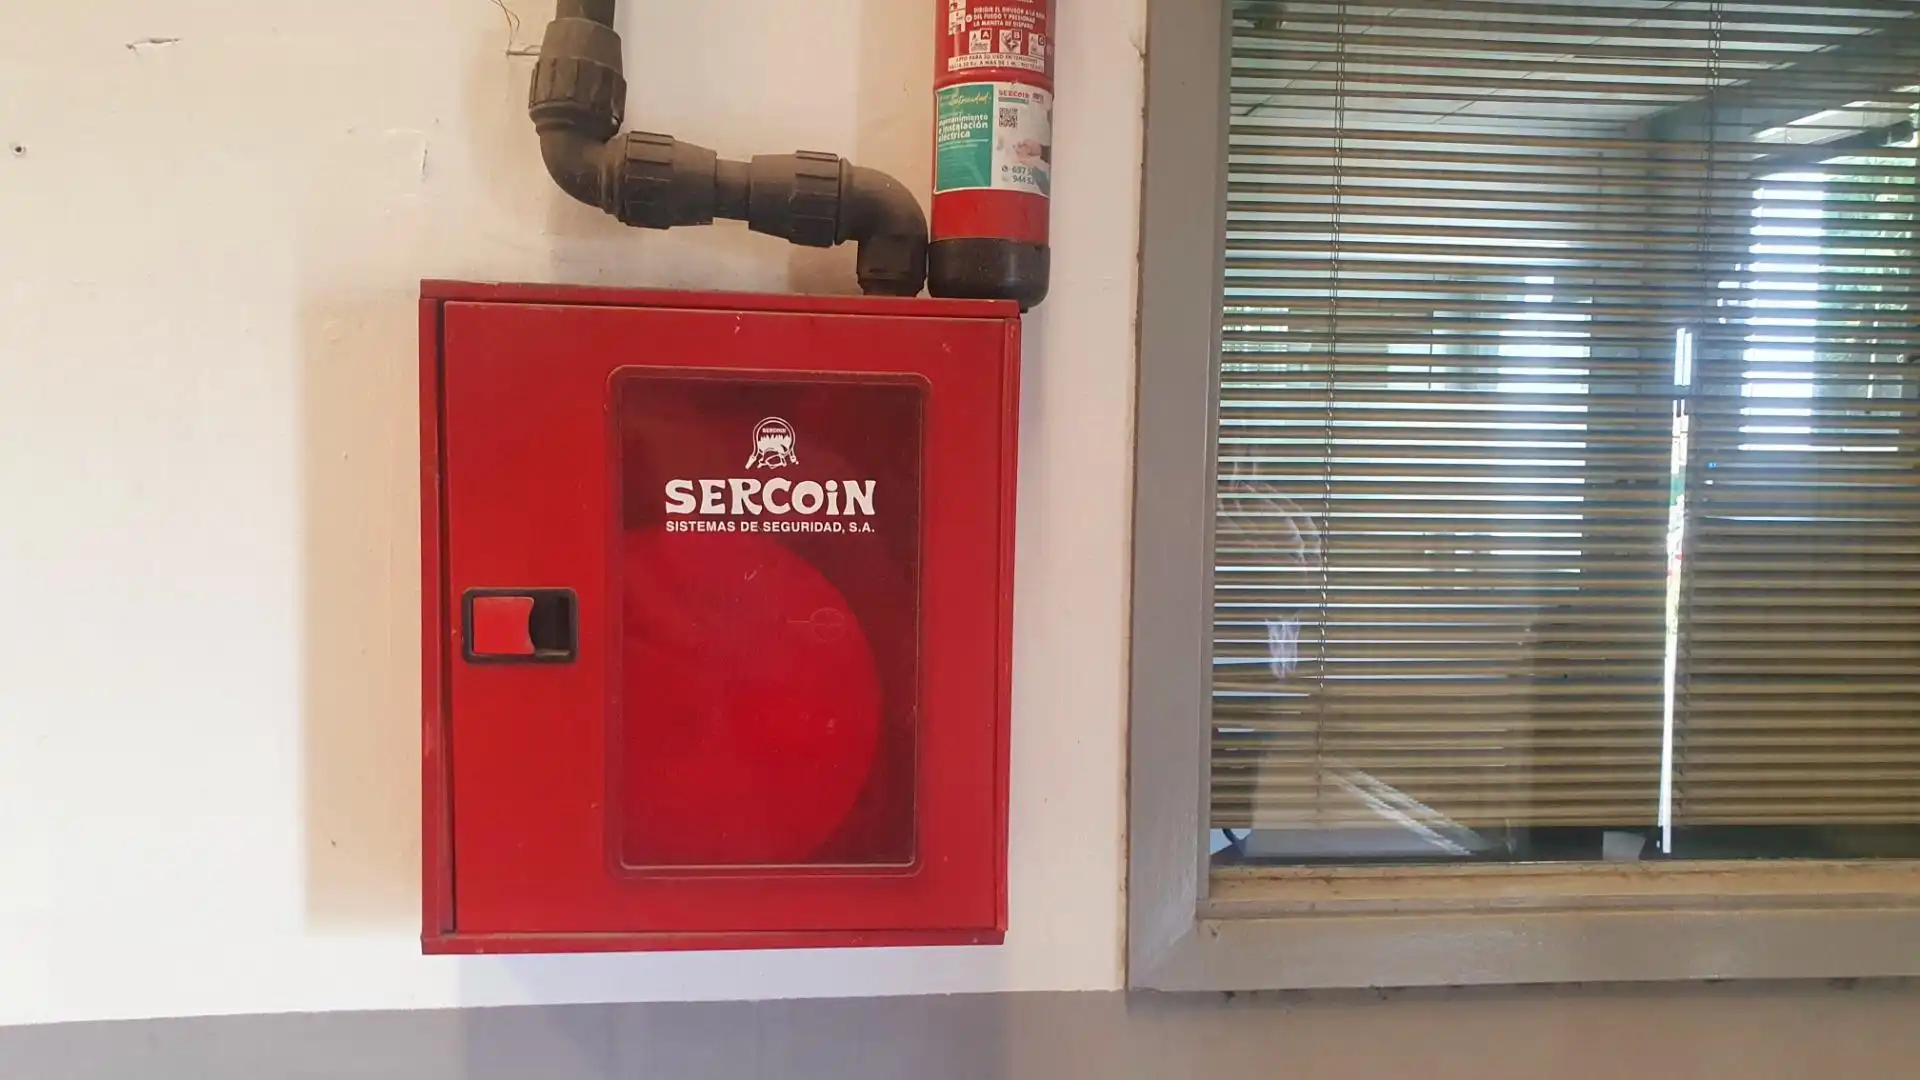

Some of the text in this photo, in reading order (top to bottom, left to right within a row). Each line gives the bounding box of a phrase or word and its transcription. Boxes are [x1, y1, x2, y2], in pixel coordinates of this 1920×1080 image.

[666, 520, 876, 535] SISTEMAS DE SEGURIDAD, S.A.
